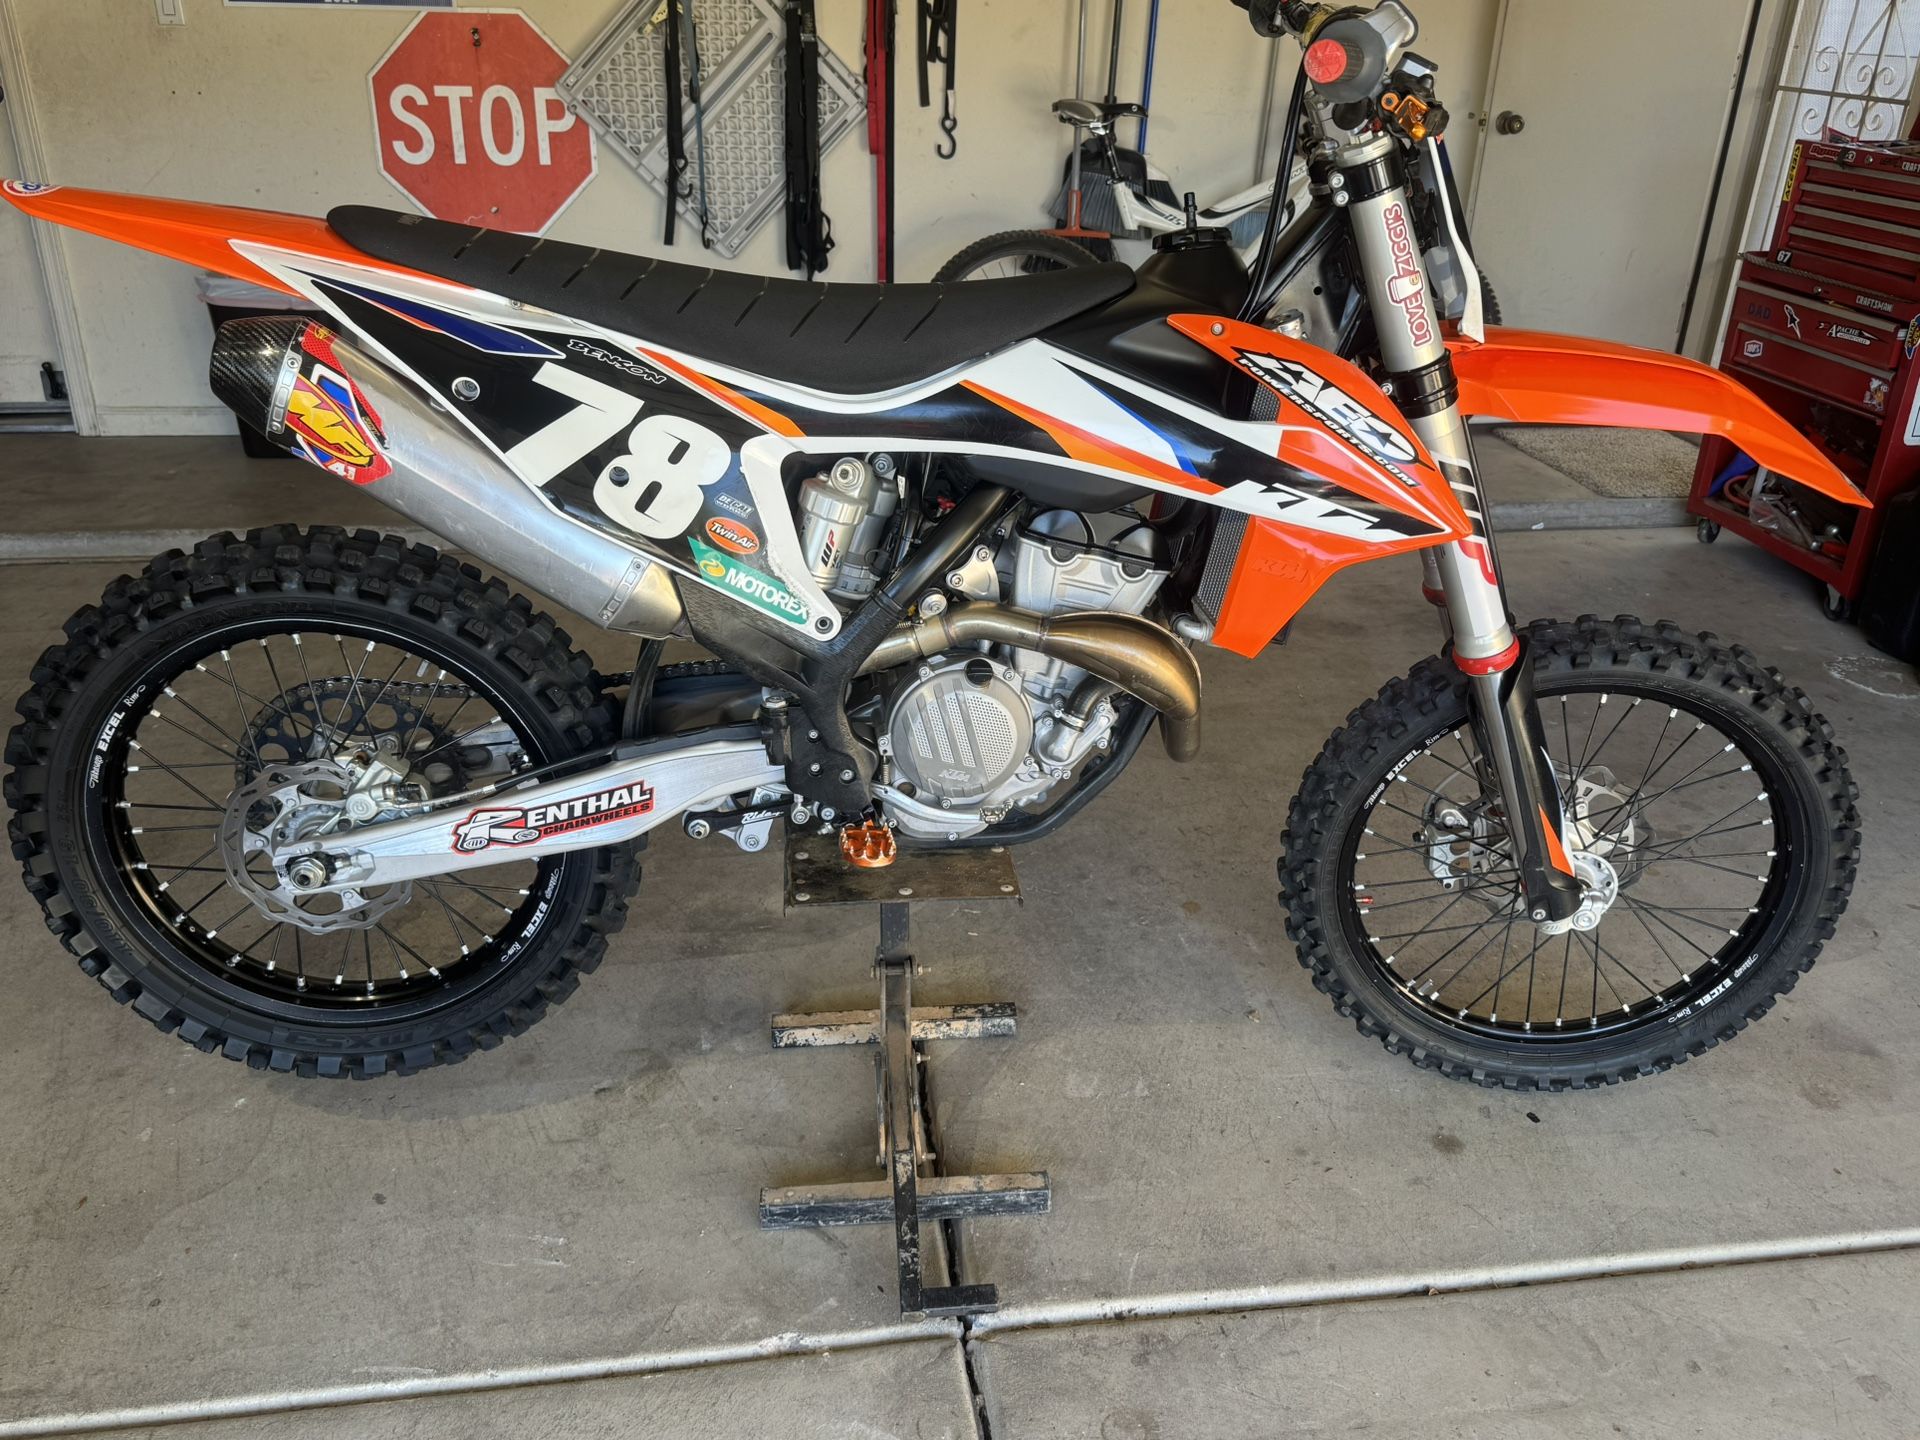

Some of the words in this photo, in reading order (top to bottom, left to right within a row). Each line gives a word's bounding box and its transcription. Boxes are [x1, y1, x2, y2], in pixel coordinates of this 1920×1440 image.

[389, 84, 577, 167] STOP
[1385, 204, 1414, 276] ZIGGI'S
[1776, 250, 1792, 263] 67
[1406, 294, 1430, 345] LOVE
[1856, 295, 1893, 312] CRAFTSMAN
[1826, 324, 1860, 338] APACHE
[567, 339, 667, 384] BENSON
[504, 361, 732, 540] 78
[1214, 479, 1412, 544] KTM
[725, 567, 808, 620] MOTOREX
[97, 711, 125, 752] EXCEL
[938, 768, 971, 783] KTM
[1385, 748, 1422, 782] EXCEL
[543, 802, 651, 836] CHAINWHEELS
[521, 901, 548, 938] EXCEL
[1694, 977, 1733, 1007] EXCEL
